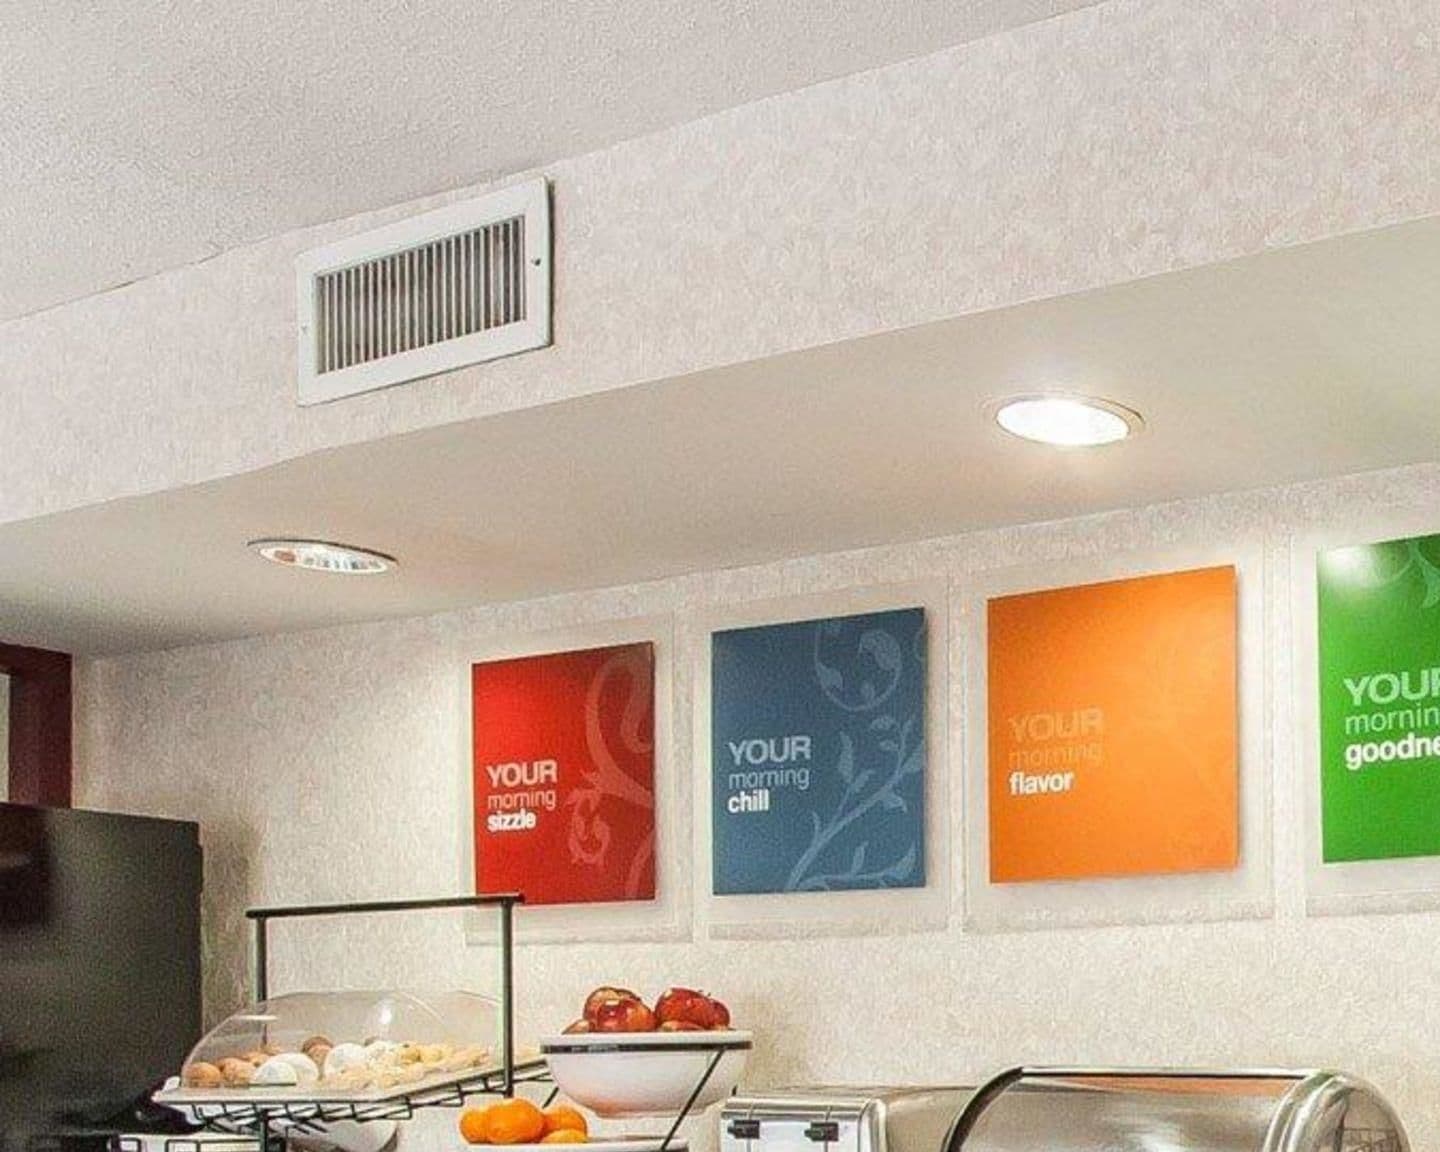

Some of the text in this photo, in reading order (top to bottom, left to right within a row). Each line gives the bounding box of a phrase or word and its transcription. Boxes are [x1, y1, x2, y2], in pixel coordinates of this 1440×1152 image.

[1008, 708, 1104, 742] YOUR
[728, 735, 812, 765] YOUR
[486, 760, 558, 788] YOUR
[729, 766, 810, 790] morning
[1009, 771, 1076, 795] flavor
[487, 789, 556, 811] morning
[728, 788, 770, 814] chill
[487, 808, 537, 833] sizzle
